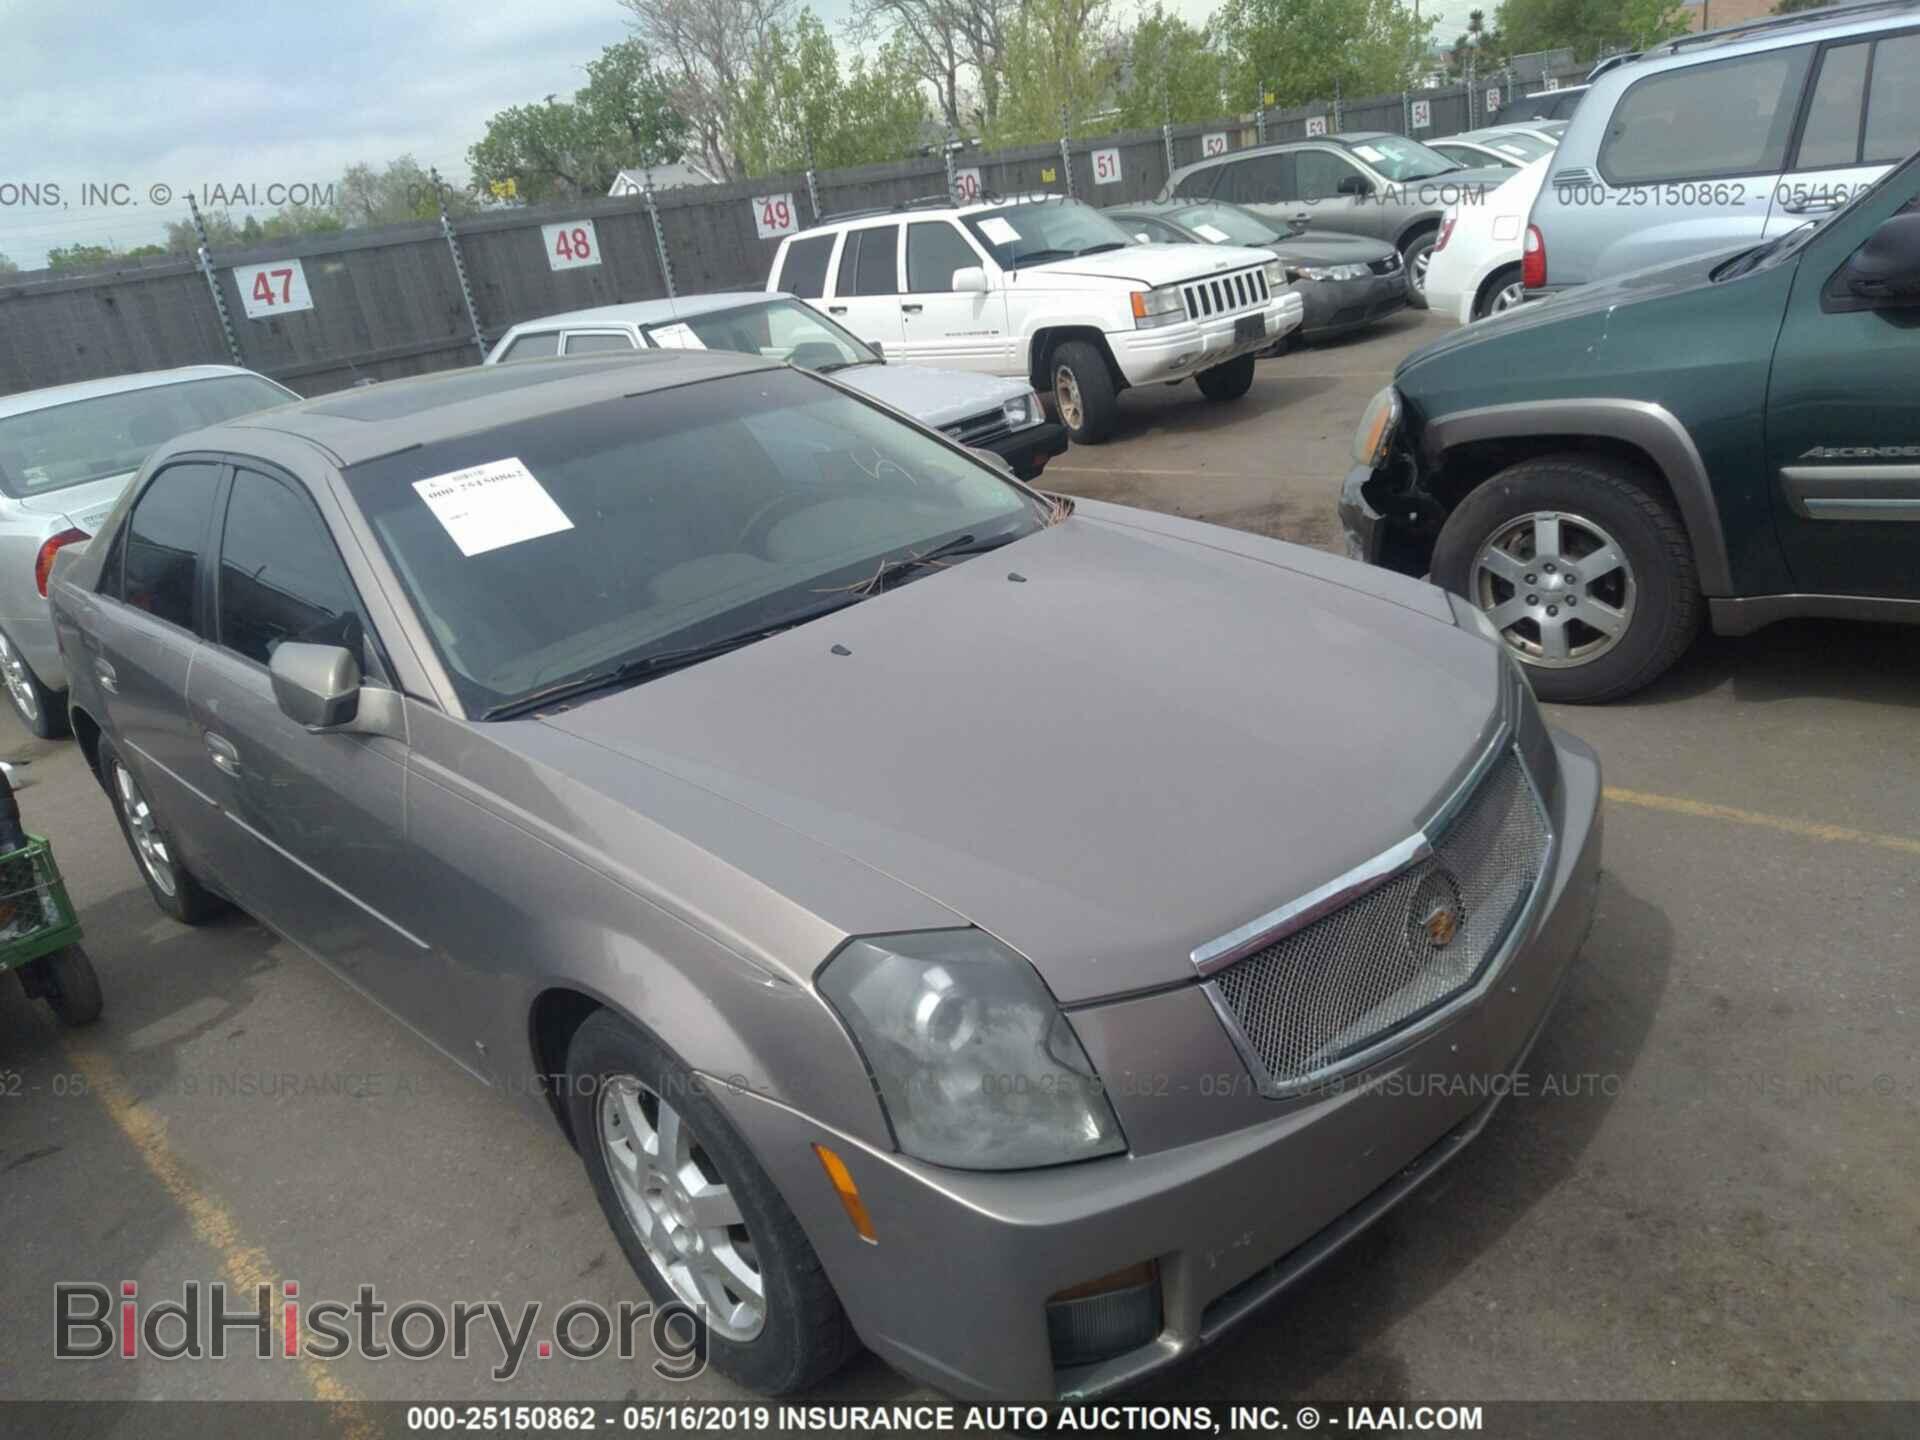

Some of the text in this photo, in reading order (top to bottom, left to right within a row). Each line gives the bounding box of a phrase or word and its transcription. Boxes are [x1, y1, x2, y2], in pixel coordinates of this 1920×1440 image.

[1097, 153, 1116, 178] 51
[956, 173, 977, 202] 50
[763, 201, 790, 230] 49
[555, 227, 592, 261] 48
[253, 268, 293, 306] 47
